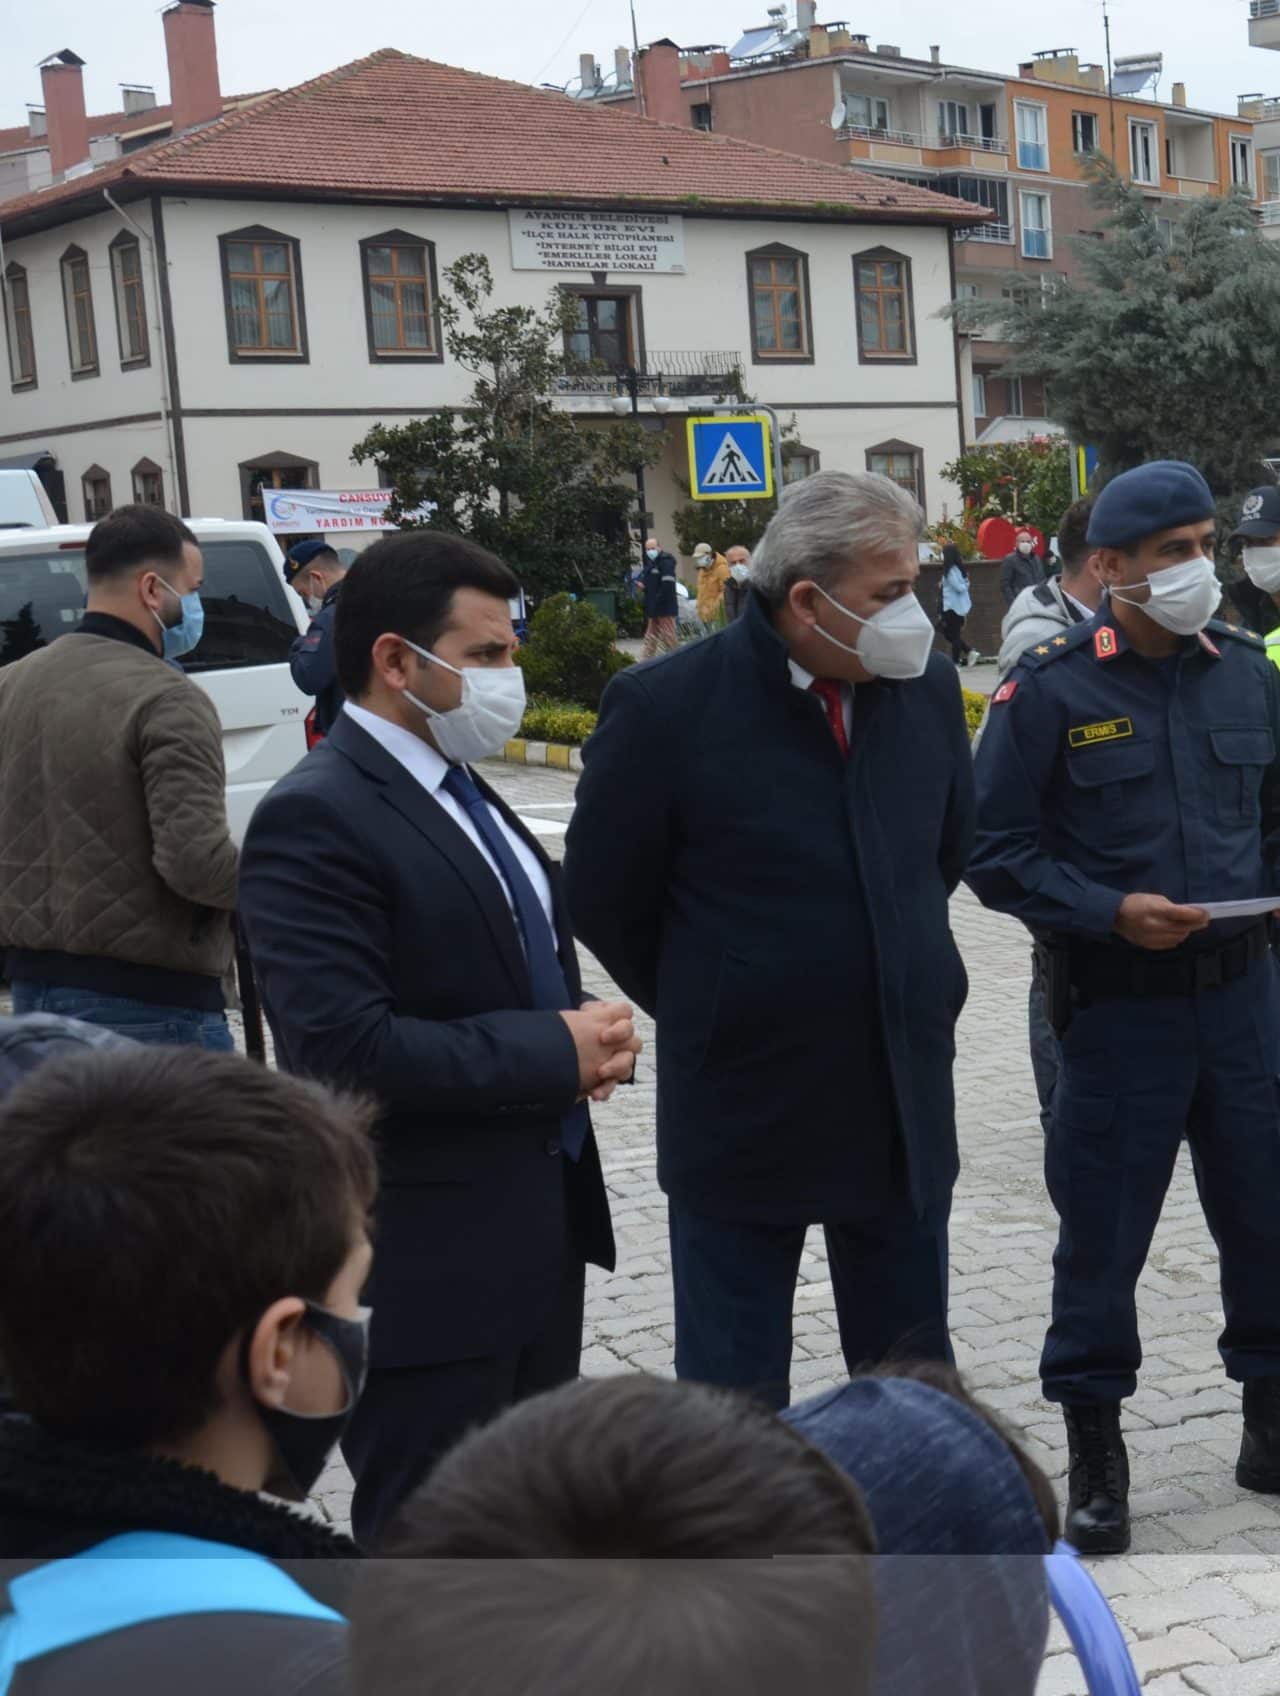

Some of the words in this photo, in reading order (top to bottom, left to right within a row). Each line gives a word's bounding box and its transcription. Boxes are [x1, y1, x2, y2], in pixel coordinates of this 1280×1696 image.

[525, 211, 586, 222] AYANCIK
[590, 212, 669, 225] BELEDİYESİ
[624, 223, 655, 233] EVİ
[316, 517, 364, 529] YARDIM
